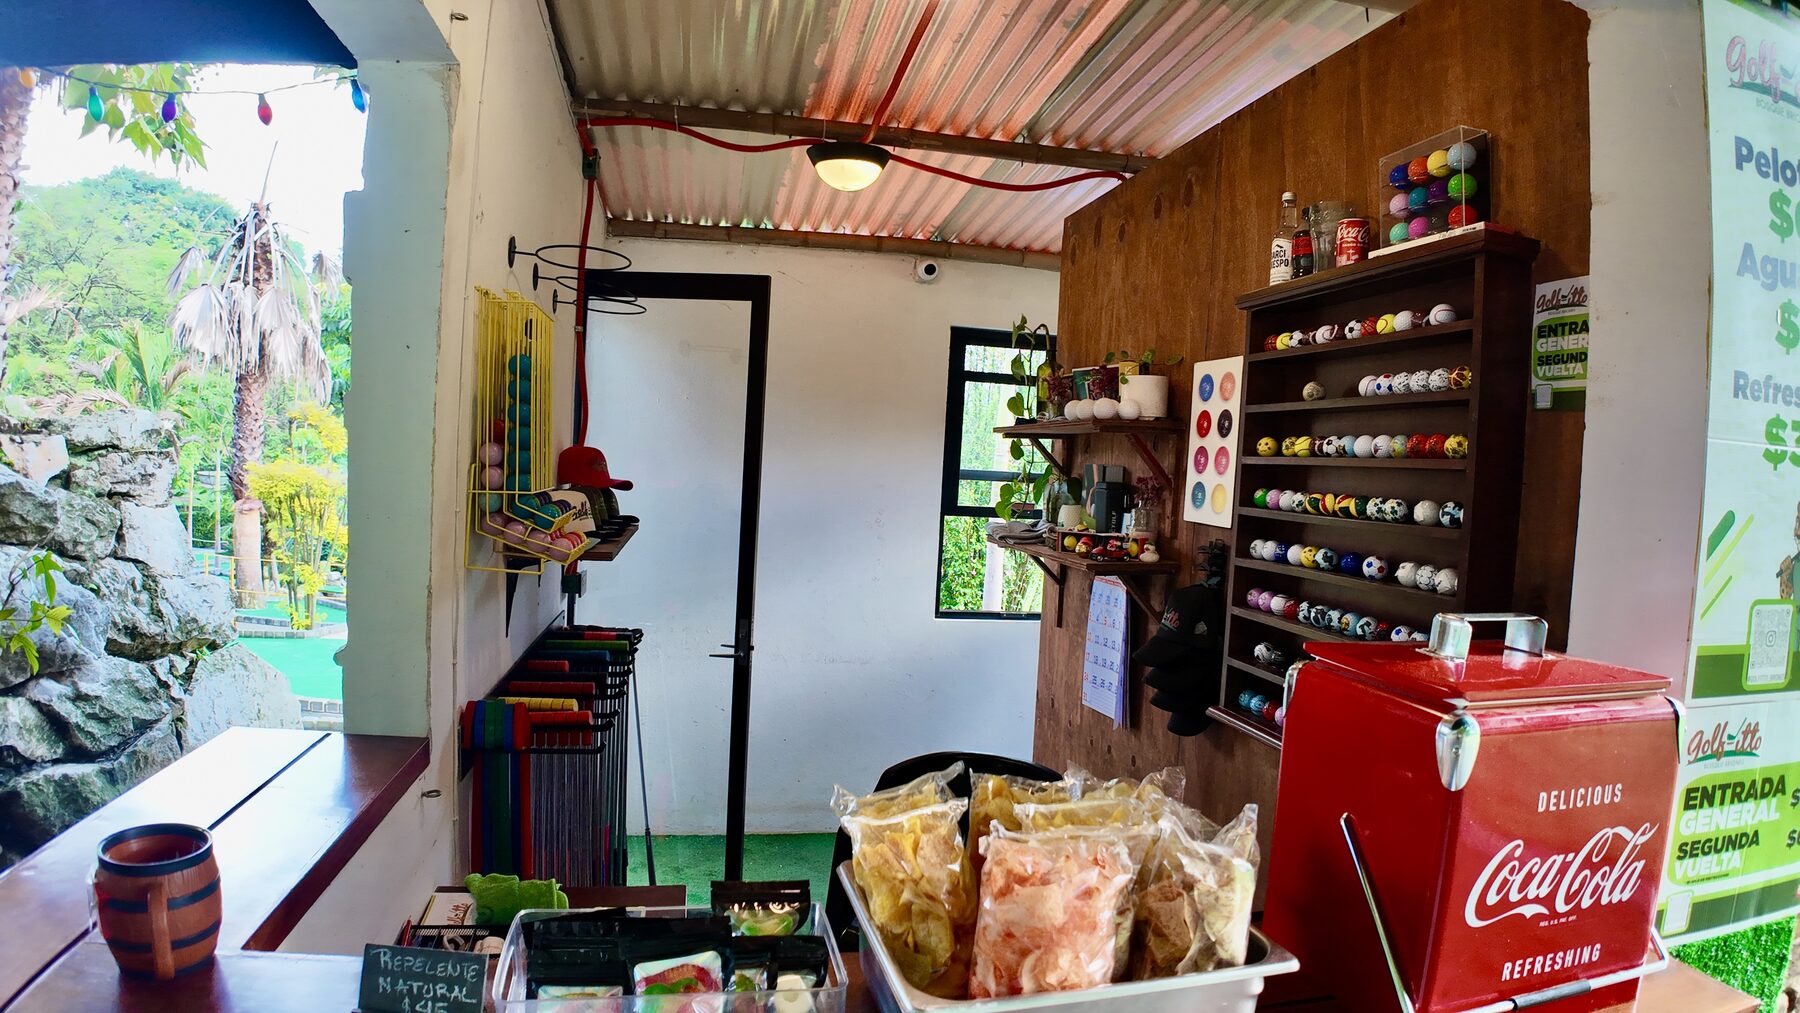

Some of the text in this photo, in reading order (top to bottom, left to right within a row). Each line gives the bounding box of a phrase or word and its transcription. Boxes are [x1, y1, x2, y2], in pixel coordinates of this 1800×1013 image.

[1726, 36, 1800, 103] Golf-
[1736, 242, 1800, 292] Agu
[1537, 364, 1583, 377] VUELTA
[1537, 783, 1622, 812] DELICIOUS
[1683, 775, 1786, 811] ENTRADA
[1679, 797, 1780, 836] GENERAL
[1676, 829, 1760, 861] SEGUNDA
[1464, 821, 1659, 928] Coca-Cola
[1674, 850, 1742, 880] VUELTA
[370, 948, 480, 982] REPELENTE
[1501, 942, 1601, 981] REFRESHING
[378, 976, 477, 1003] NATURAL
